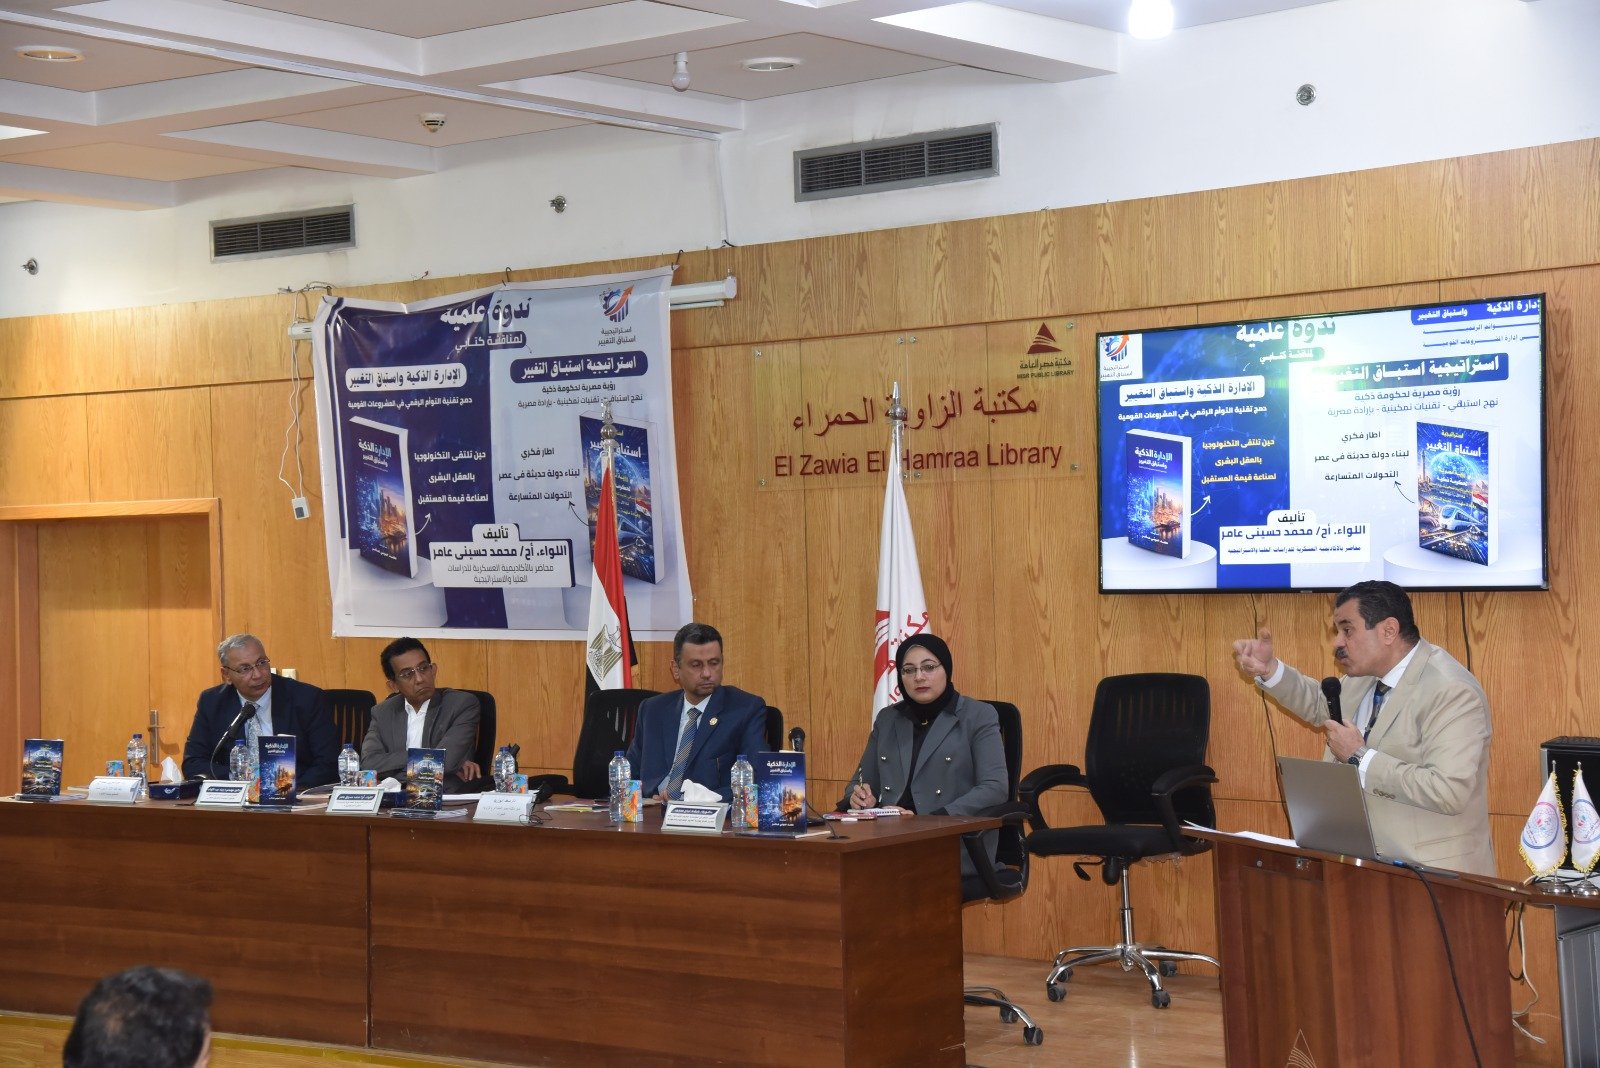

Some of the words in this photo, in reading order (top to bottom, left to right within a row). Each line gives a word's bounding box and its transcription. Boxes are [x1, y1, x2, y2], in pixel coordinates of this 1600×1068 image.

[1517, 299, 1540, 312] دارة
[492, 297, 532, 328] ندوة
[550, 358, 584, 378] استباق
[586, 356, 636, 374] استراتيجية
[1429, 355, 1499, 376] استراتيجية
[434, 368, 460, 384] الإدارة
[521, 362, 548, 380] التغيير
[1373, 361, 1425, 382] استباق
[350, 372, 374, 388] التغيير
[406, 369, 431, 386] الذكية
[1377, 390, 1410, 402] لحكومة
[1412, 390, 1440, 399] مصرية
[972, 386, 1038, 424] مكتبة
[793, 396, 874, 436] الحمراء
[1342, 432, 1364, 443] فكري
[1202, 440, 1239, 449] التكنولوجيا
[414, 452, 450, 462] التكنولوجيا
[521, 448, 540, 460] فكري
[1314, 455, 1330, 463] عصر
[1392, 450, 1410, 459] لبناء
[774, 455, 793, 477] El
[800, 452, 858, 476] Zawia
[867, 450, 885, 472] El
[986, 444, 1062, 468] Library
[498, 472, 512, 481] عصر
[547, 469, 563, 479] دولة
[564, 469, 580, 478] لبناء
[1325, 472, 1363, 482] المتسارعة
[1366, 471, 1399, 480] التحولات
[1201, 475, 1233, 484] المستقبل
[418, 495, 446, 504] المستقبل
[466, 494, 488, 502] لصناعة
[508, 492, 542, 502] المتسارعة
[544, 491, 572, 501] التحولات
[1278, 511, 1305, 524] تأليف
[482, 526, 509, 542] تأليف
[1222, 529, 1243, 540] عامر
[433, 547, 453, 559] عامر
[490, 548, 517, 557] محمد
